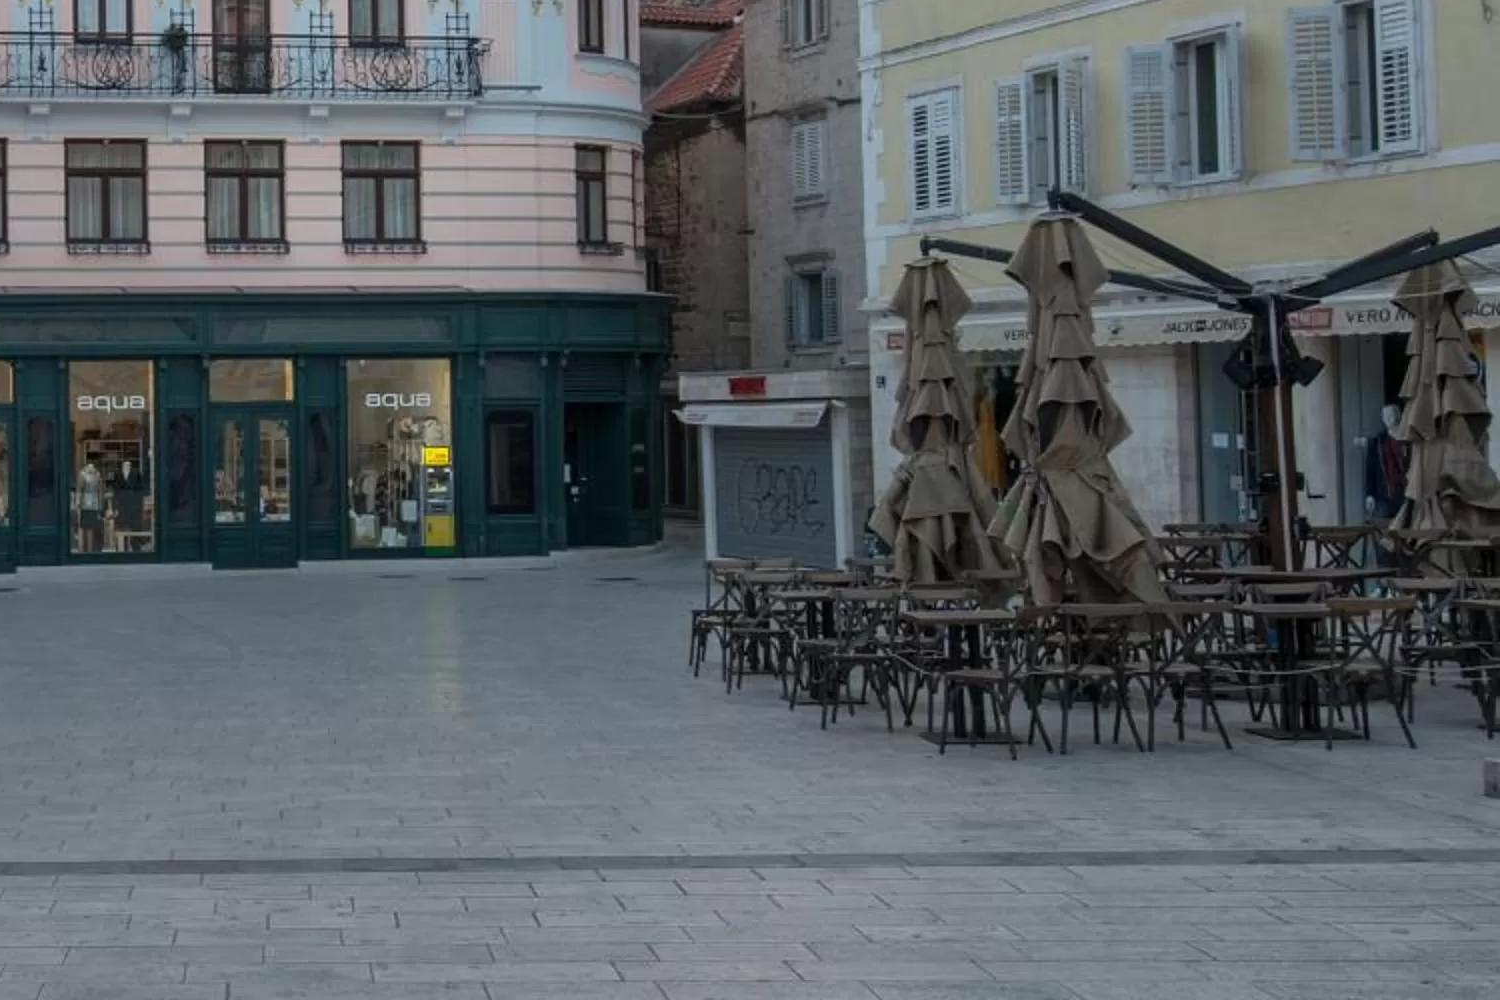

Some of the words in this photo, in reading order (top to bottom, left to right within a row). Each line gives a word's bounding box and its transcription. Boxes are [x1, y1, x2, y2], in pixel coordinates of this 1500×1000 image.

[1347, 307, 1390, 324] VERO
[77, 395, 145, 414] aqua
[365, 393, 431, 410] aqua
